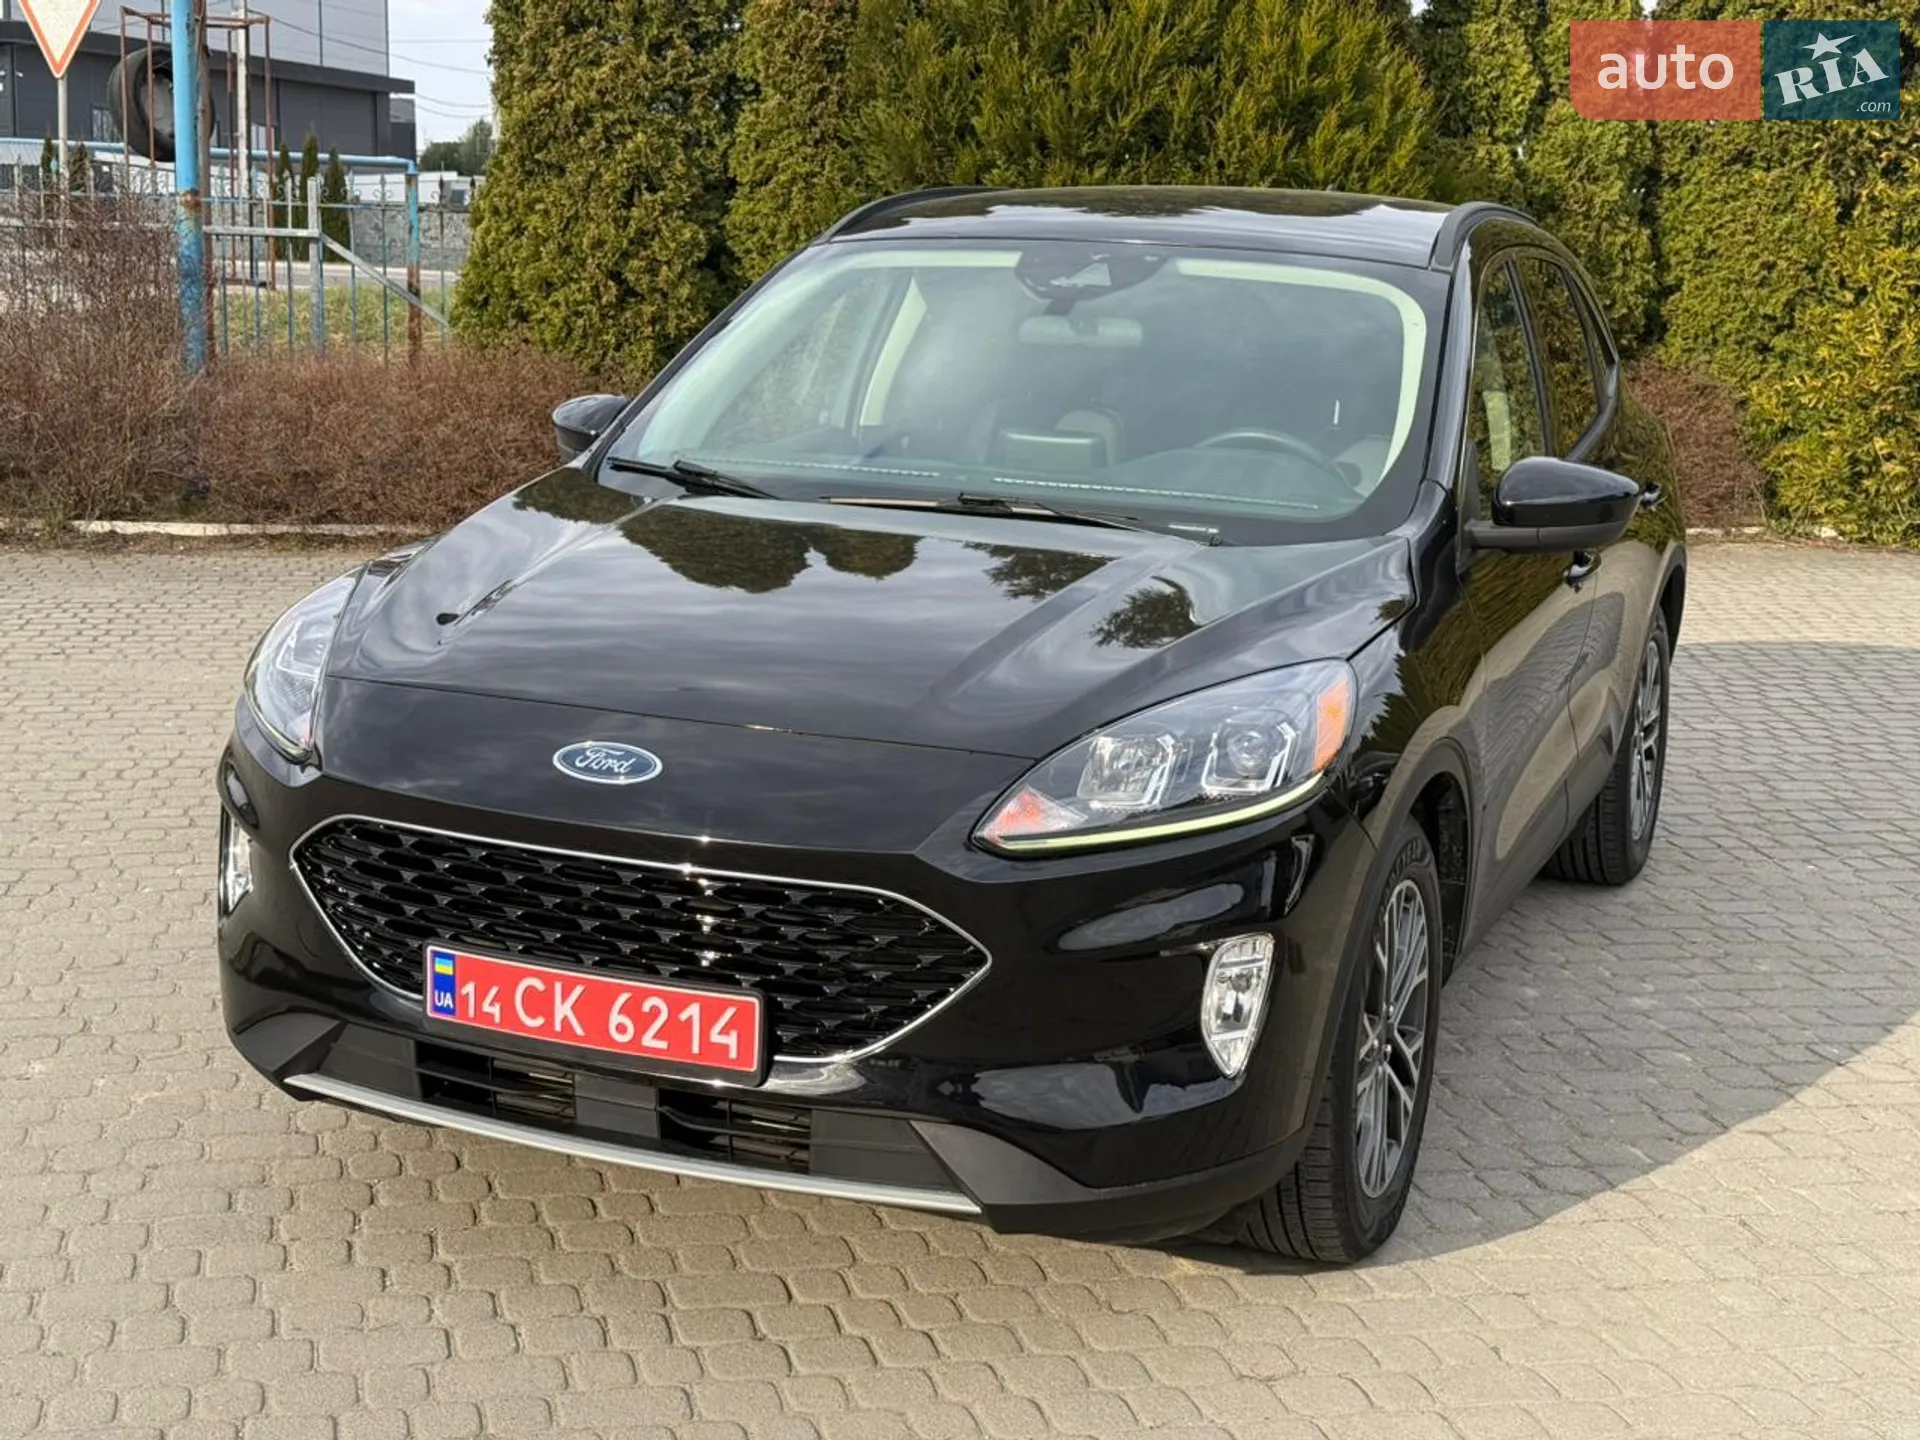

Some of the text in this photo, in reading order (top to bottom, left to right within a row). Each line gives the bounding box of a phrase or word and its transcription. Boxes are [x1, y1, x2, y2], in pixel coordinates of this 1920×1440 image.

[575, 747, 637, 774] Ford
[434, 990, 454, 1009] UA
[460, 977, 739, 1060] 14 CK 6214
